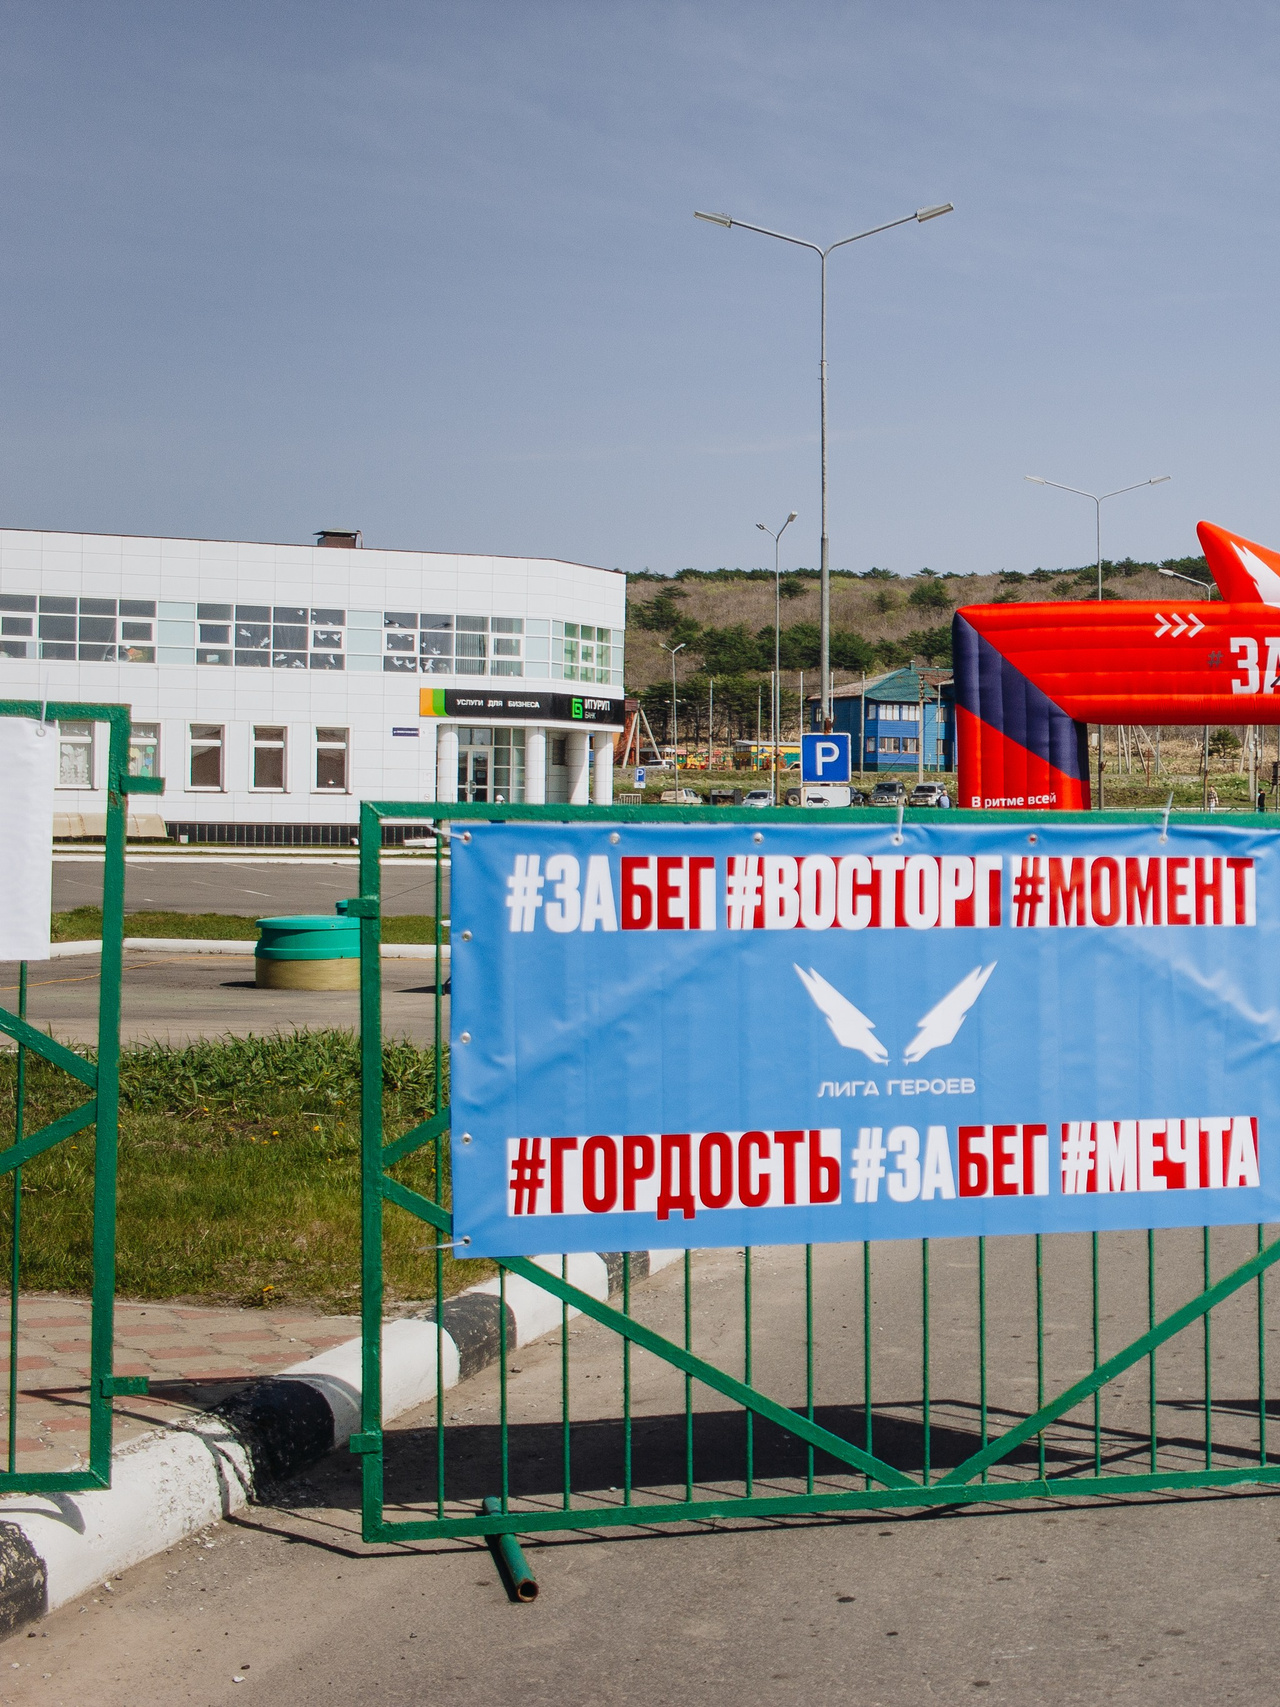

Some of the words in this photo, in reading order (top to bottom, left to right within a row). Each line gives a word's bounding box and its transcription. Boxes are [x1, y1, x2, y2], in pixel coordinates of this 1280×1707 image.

[456, 698, 484, 707] УСЛУГИ
[487, 699, 503, 708] ДЛЯ
[507, 700, 540, 709] БИЗНЕСА
[584, 698, 611, 711] ИТУРУП
[816, 742, 840, 776] P
[971, 796, 981, 808] В
[984, 796, 1025, 809] ритме
[1028, 792, 1057, 805] всей
[506, 854, 717, 934] #ЗАБЕГ
[726, 854, 1003, 930] #ВОСТОРГ
[1011, 856, 1256, 928] #МОМЕНТ
[817, 1080, 880, 1098] ЛИГА
[887, 1077, 976, 1096] ГЕРОЕВ
[509, 1130, 840, 1220] #ГОРДОСТЬ
[850, 1124, 1049, 1202] #ЗАБЕГ
[1061, 1116, 1260, 1194] #МЕЧТА
